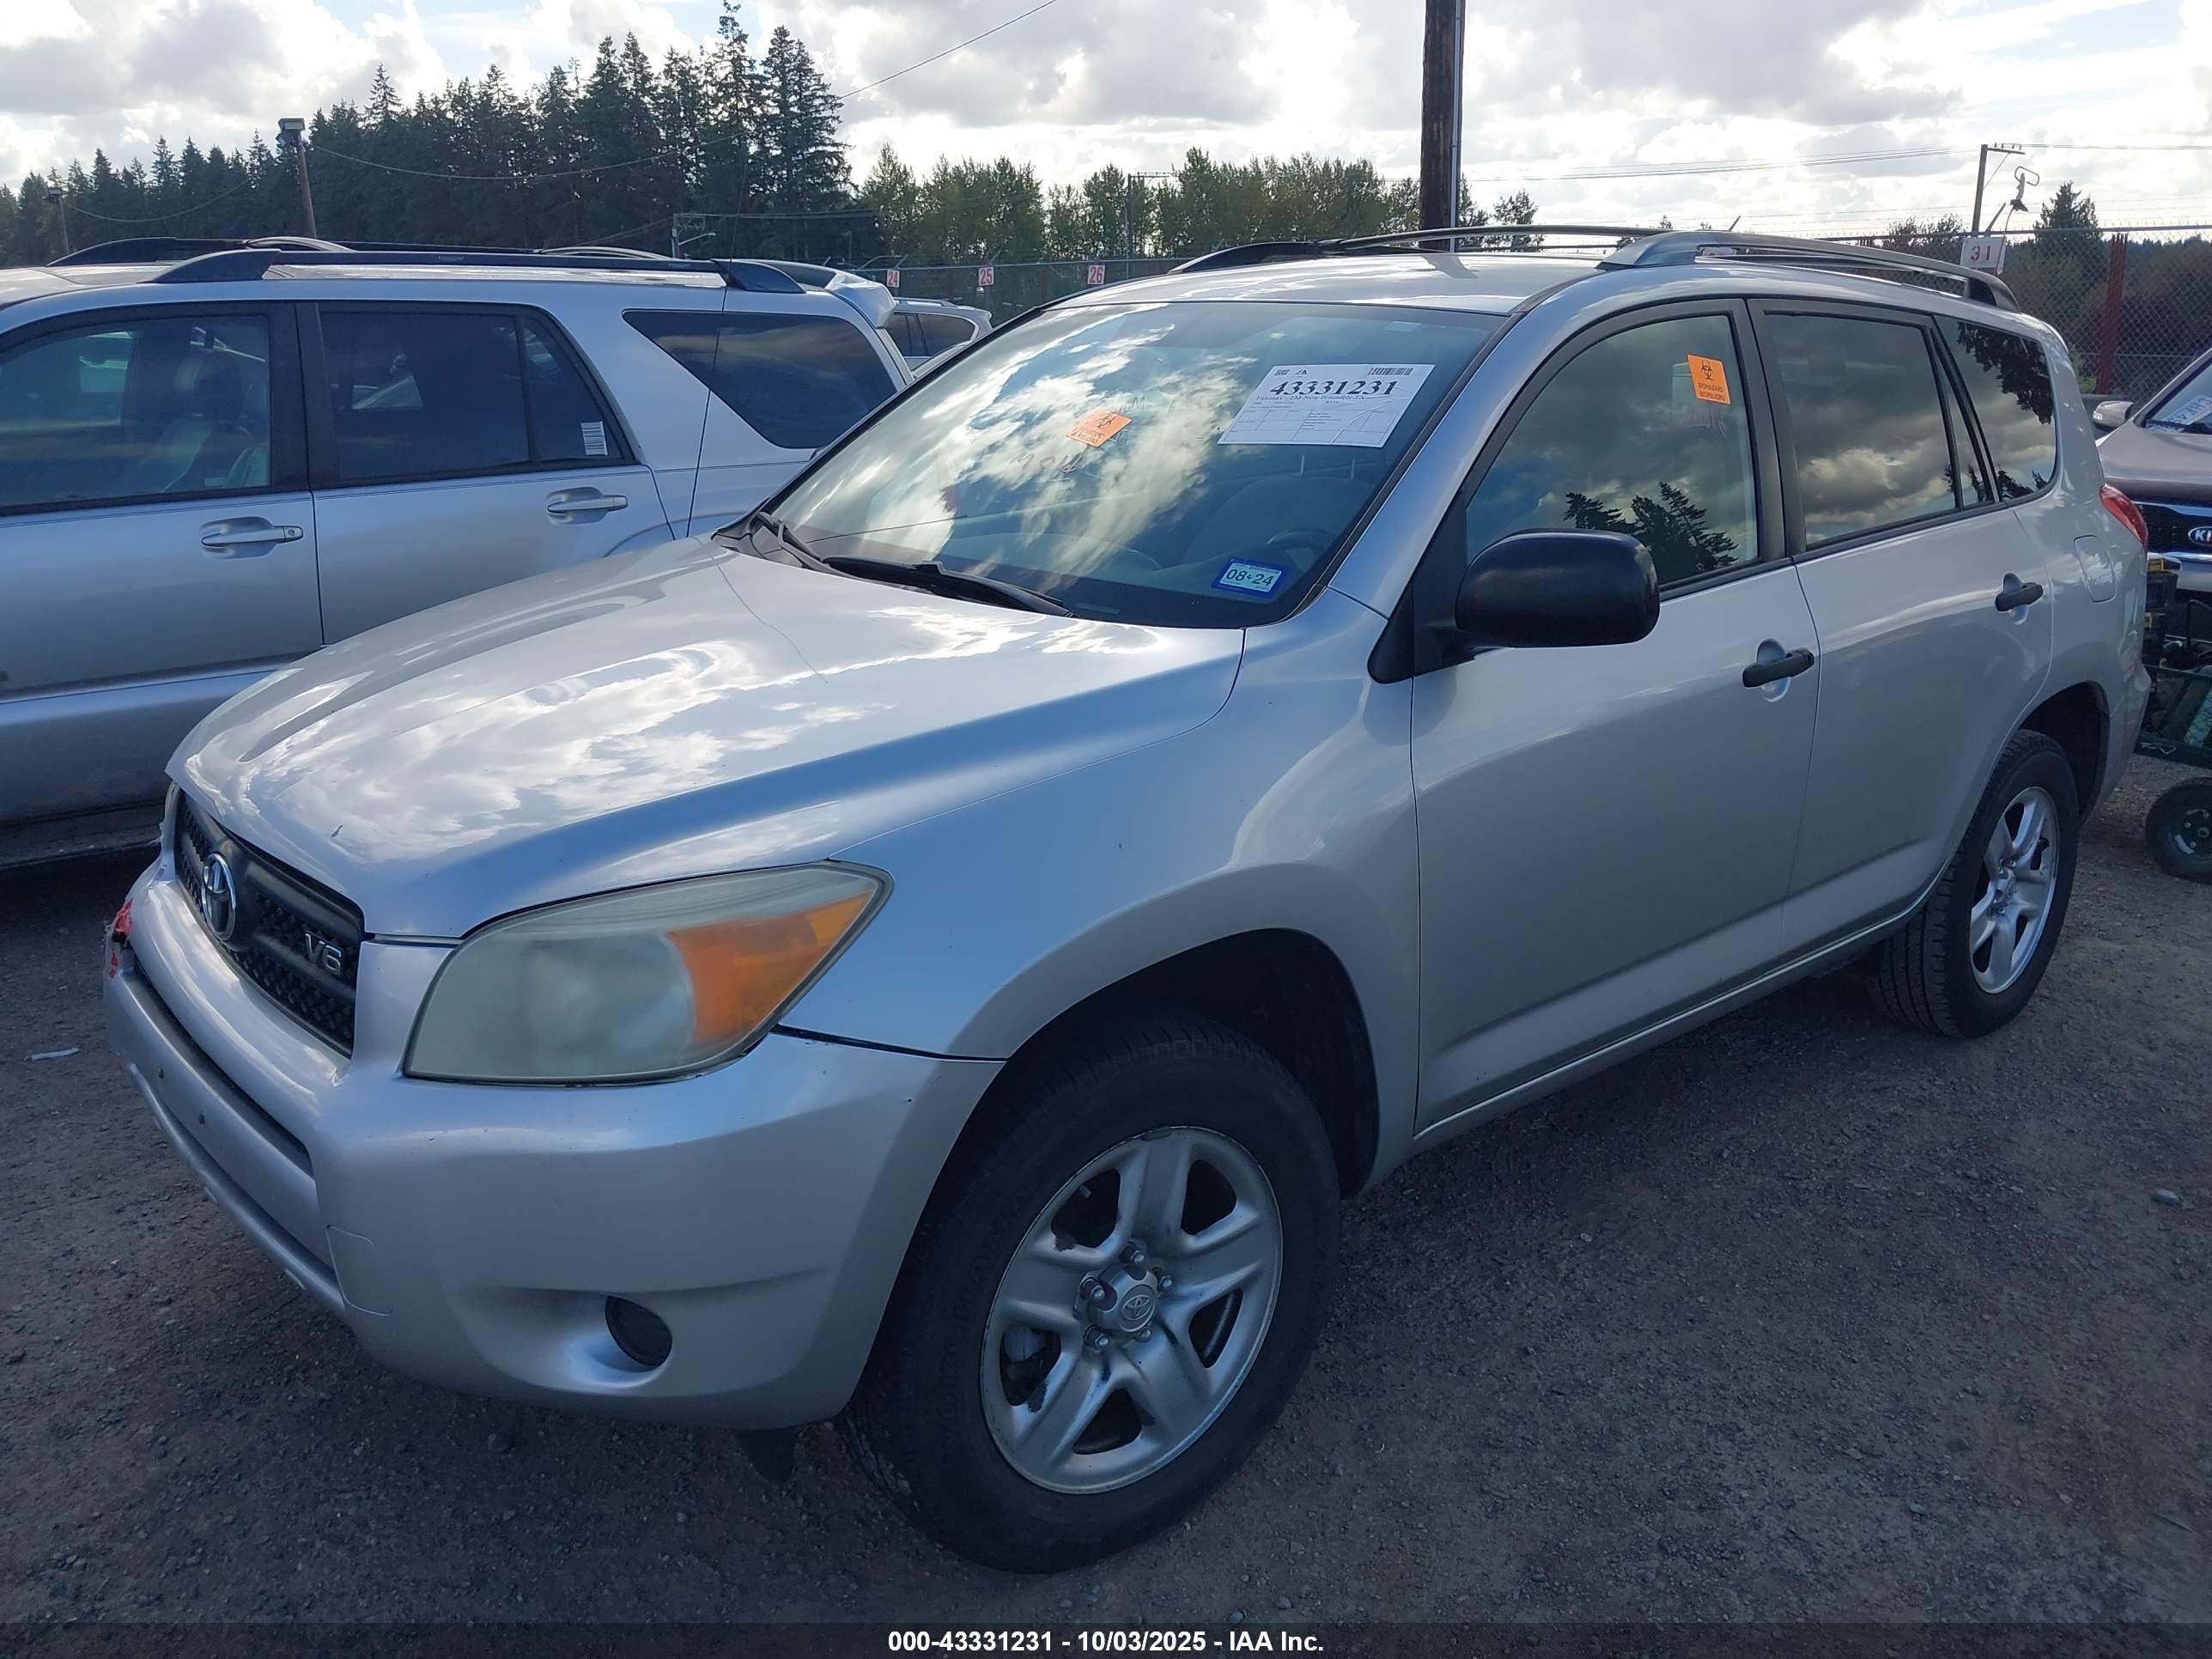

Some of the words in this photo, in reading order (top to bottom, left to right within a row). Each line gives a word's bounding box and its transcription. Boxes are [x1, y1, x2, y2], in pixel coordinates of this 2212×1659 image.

[1971, 246, 1991, 261] 31
[888, 271, 898, 287] 24
[980, 268, 993, 285] 25
[1089, 266, 1103, 284] 26
[1270, 380, 1398, 397] 43331231
[305, 933, 343, 973] V6
